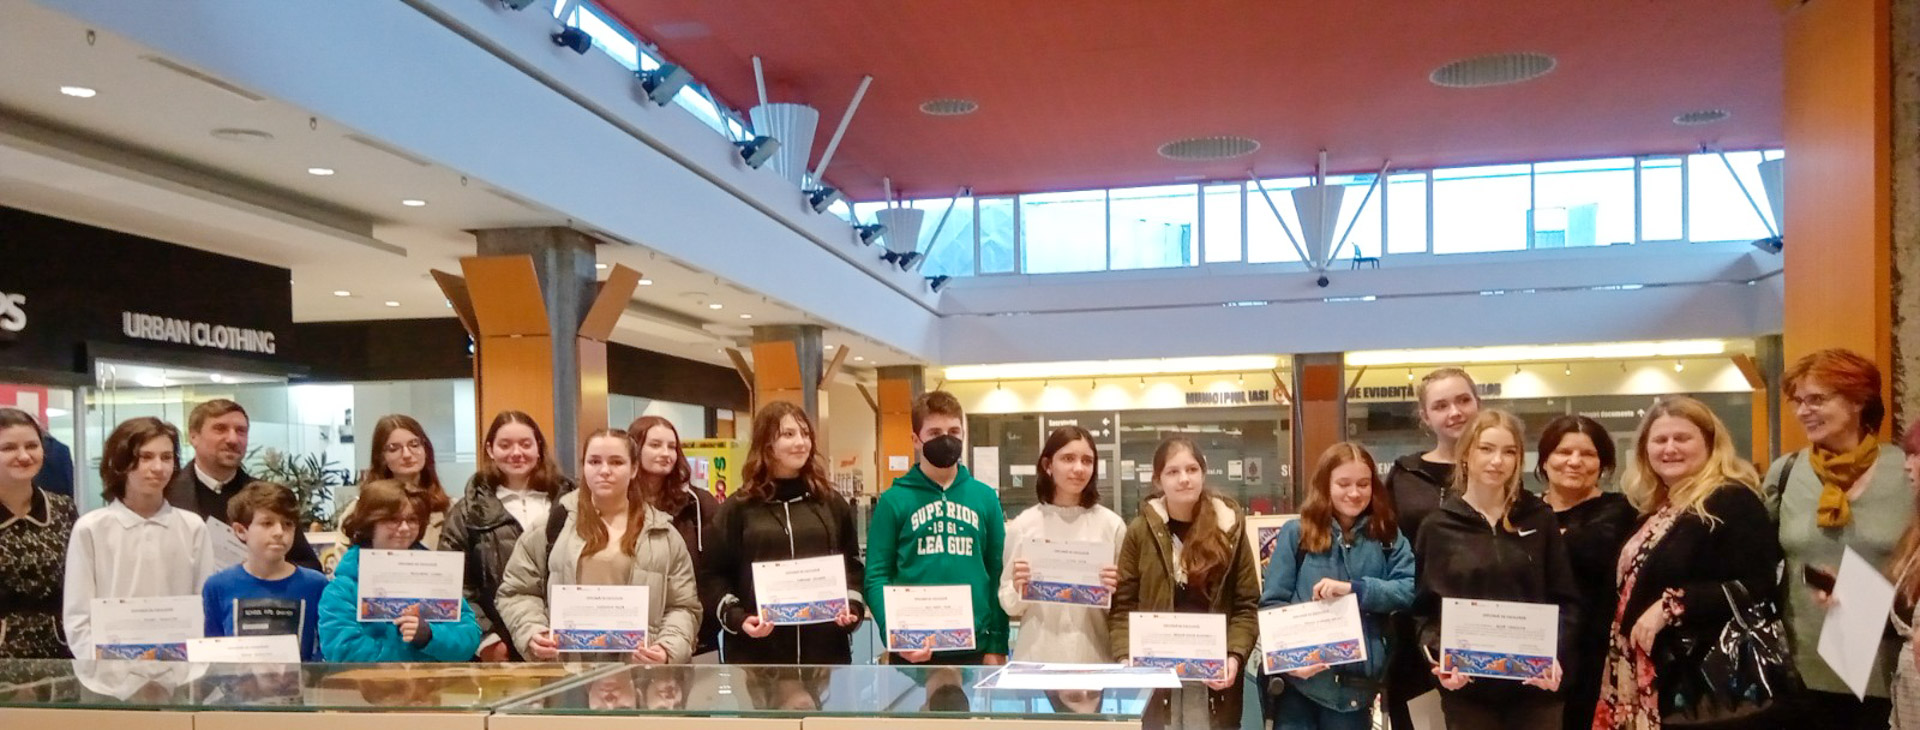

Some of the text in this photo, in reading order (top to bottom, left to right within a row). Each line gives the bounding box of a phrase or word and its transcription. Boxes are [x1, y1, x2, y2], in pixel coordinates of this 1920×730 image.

[122, 311, 275, 354] URBAN CLOTHING
[911, 500, 979, 532] SUPERIOR
[917, 534, 973, 557] LEAGUE
